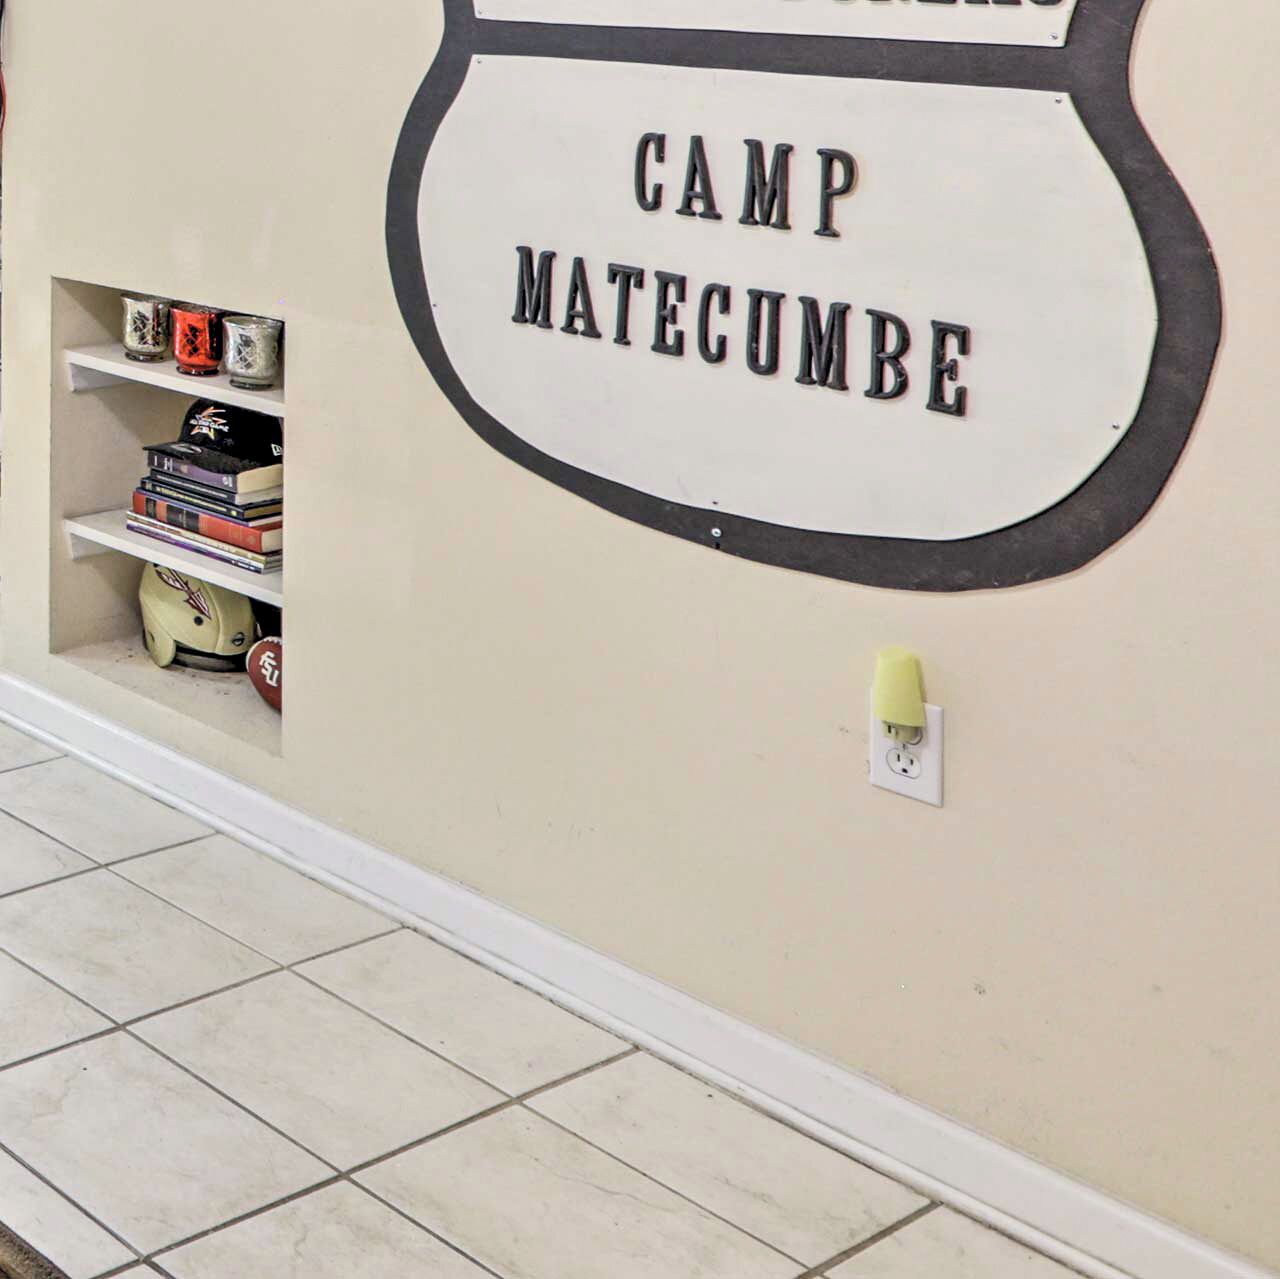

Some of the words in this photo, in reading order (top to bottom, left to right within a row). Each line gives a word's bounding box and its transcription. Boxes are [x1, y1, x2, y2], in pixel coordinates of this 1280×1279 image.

[634, 132, 858, 238] CAMP
[512, 245, 971, 417] MATECUMBE
[259, 650, 280, 688] FSU
